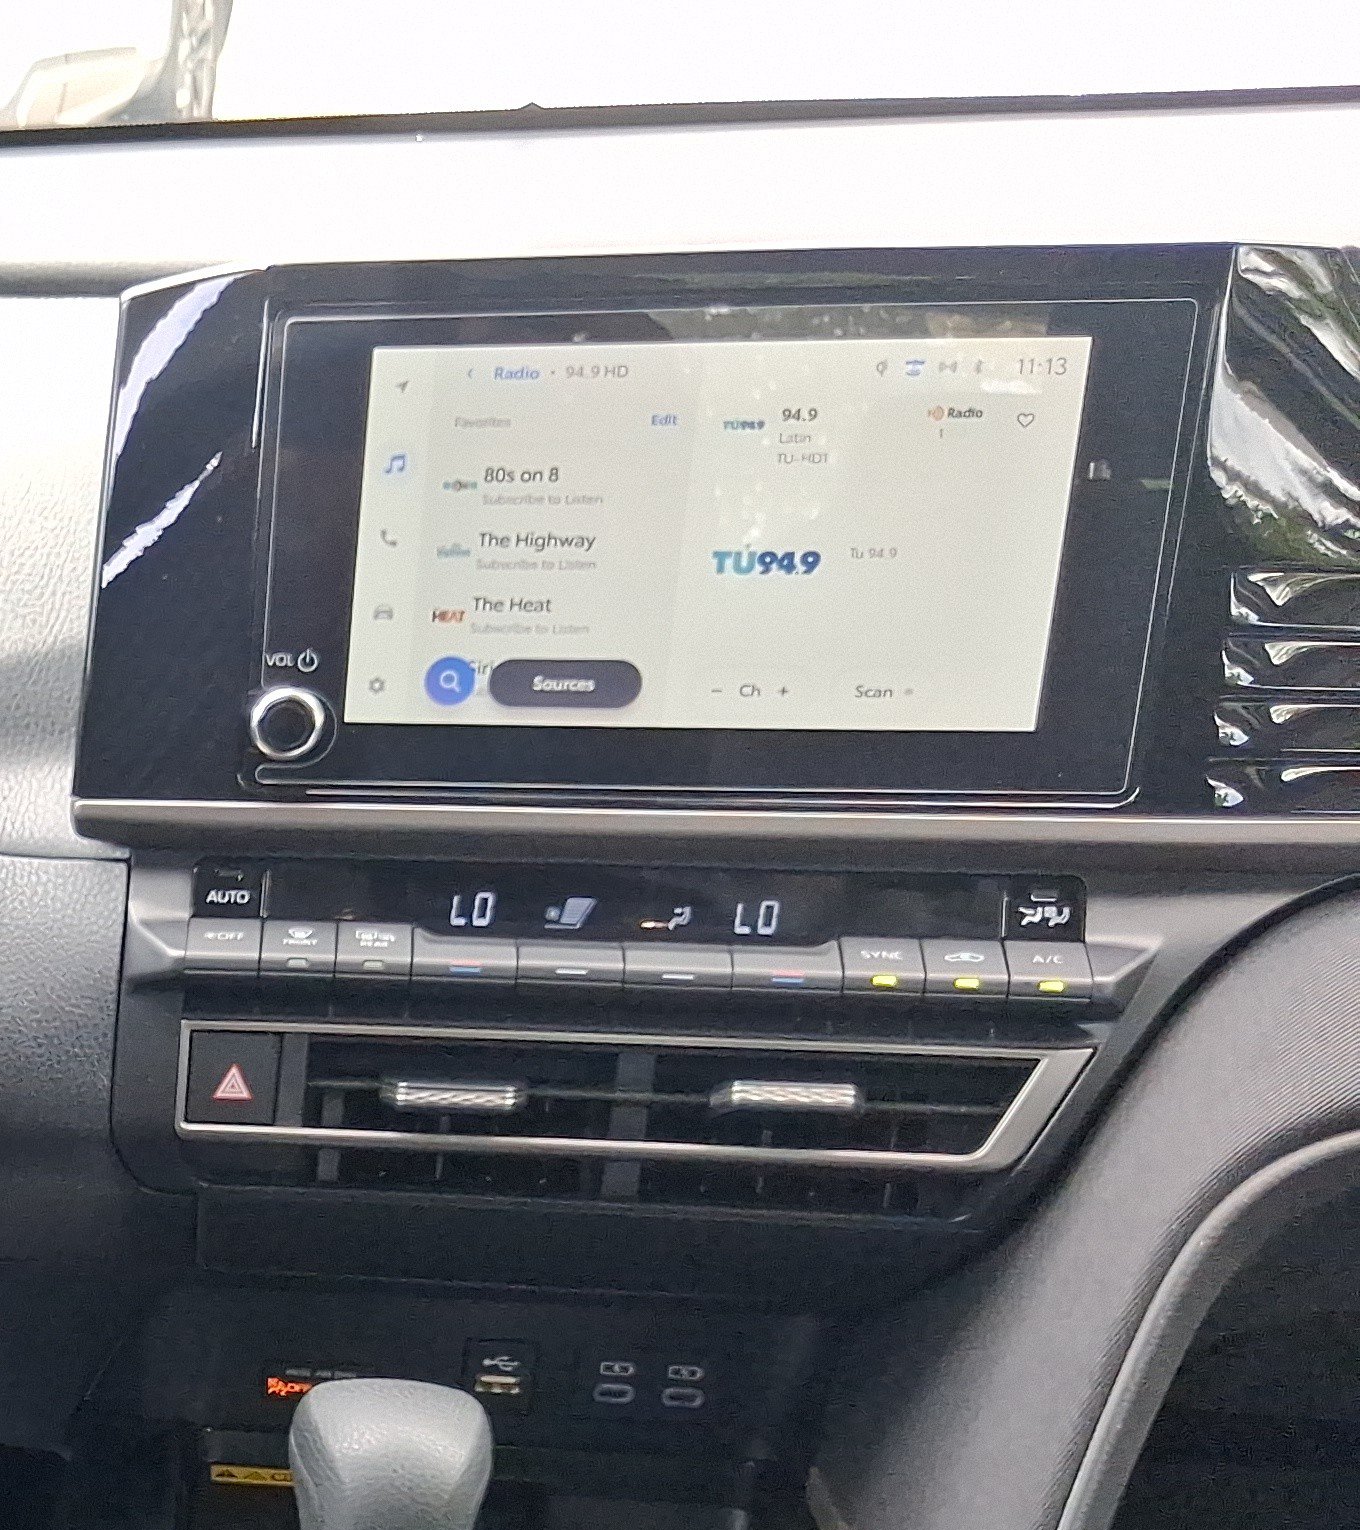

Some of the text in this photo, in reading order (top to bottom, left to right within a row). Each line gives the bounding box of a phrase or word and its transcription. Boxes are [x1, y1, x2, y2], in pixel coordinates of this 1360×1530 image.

[493, 365, 540, 380] Radio
[603, 364, 629, 379] HD
[1017, 356, 1067, 376] 11:13
[650, 413, 678, 427] Edit
[782, 407, 818, 422] 94.9
[947, 406, 983, 419] Radio
[483, 466, 560, 483] 80s on 8
[479, 532, 597, 553] The Highway
[473, 597, 552, 613] The Heat
[266, 652, 295, 668] VOL
[532, 676, 596, 693] Sources
[738, 684, 761, 698] Ch
[854, 685, 893, 699] Scan
[206, 888, 251, 906] AUTO
[449, 890, 496, 928] LO
[733, 899, 780, 938] LO
[859, 948, 904, 962] SYNC
[1032, 952, 1064, 966] A/C
